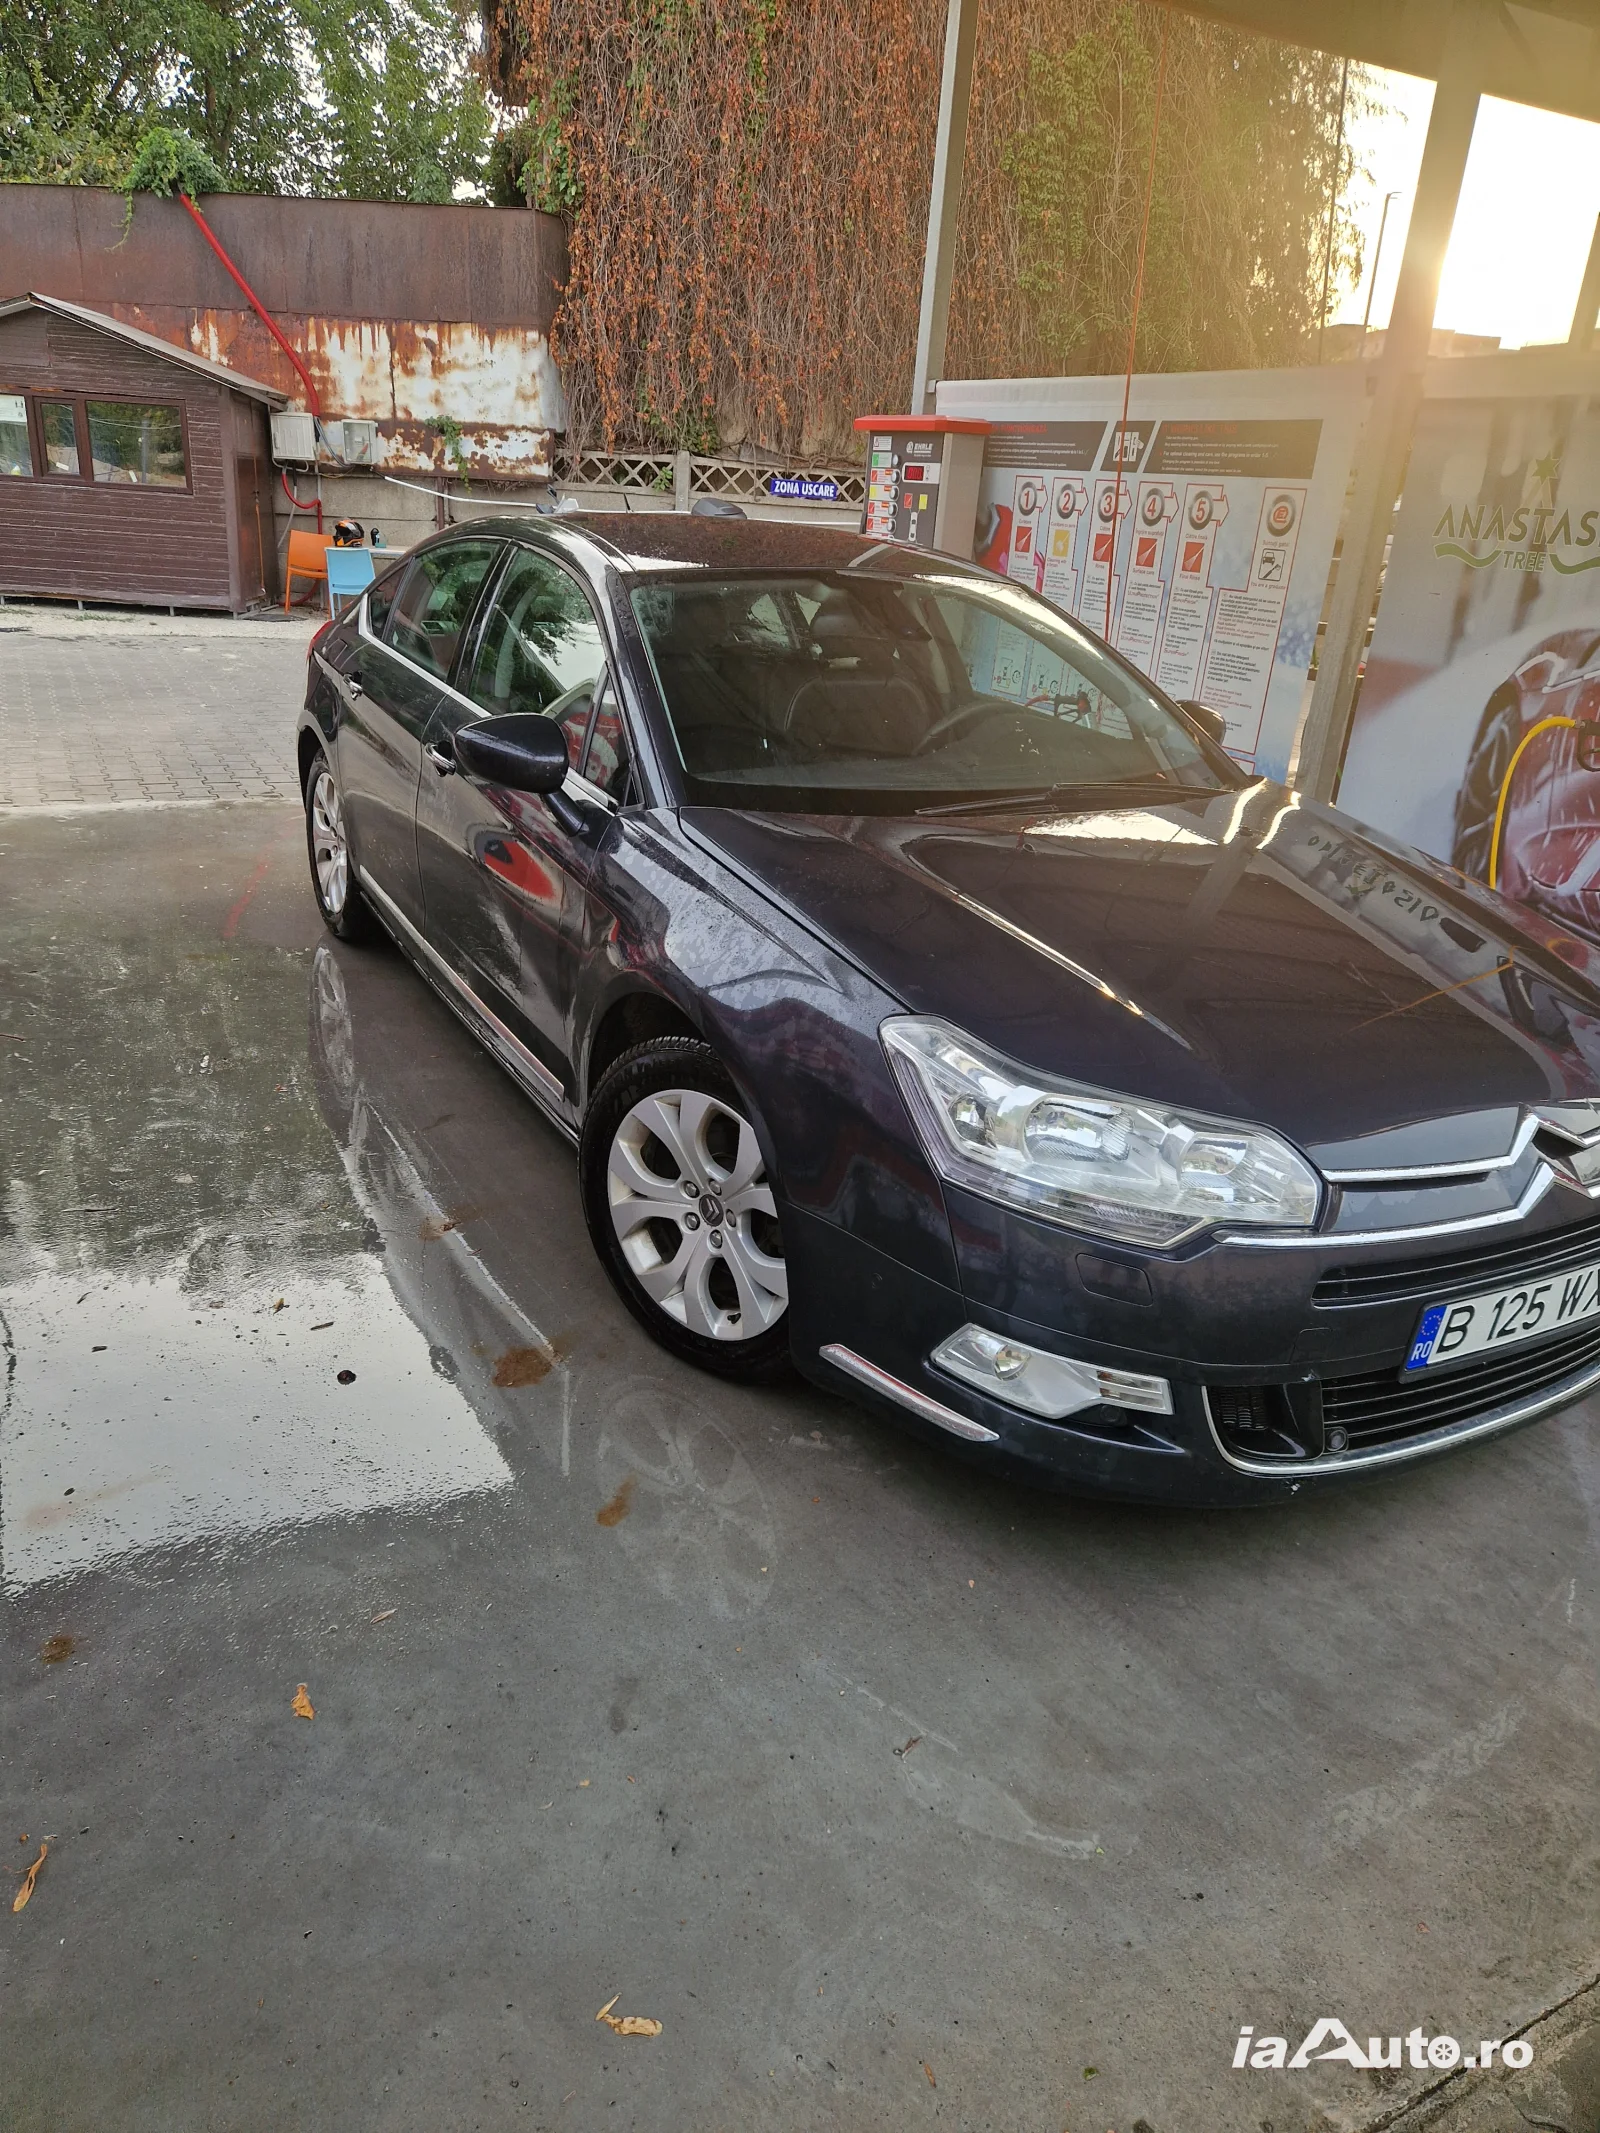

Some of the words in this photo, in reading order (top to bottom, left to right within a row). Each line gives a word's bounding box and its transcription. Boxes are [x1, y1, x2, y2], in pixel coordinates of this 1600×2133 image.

[774, 481, 800, 496] ZONA
[801, 483, 835, 498] USCARE
[1024, 490, 1030, 508] 1
[1062, 492, 1071, 511] 2
[1104, 495, 1112, 514] 3
[1147, 498, 1156, 516] 4
[1196, 499, 1206, 521] 5
[1432, 503, 1600, 547] ANASTAS
[1502, 550, 1547, 572] TREE
[1436, 1305, 1475, 1354] B
[1486, 1284, 1552, 1341] 125
[1411, 1341, 1432, 1362] RO
